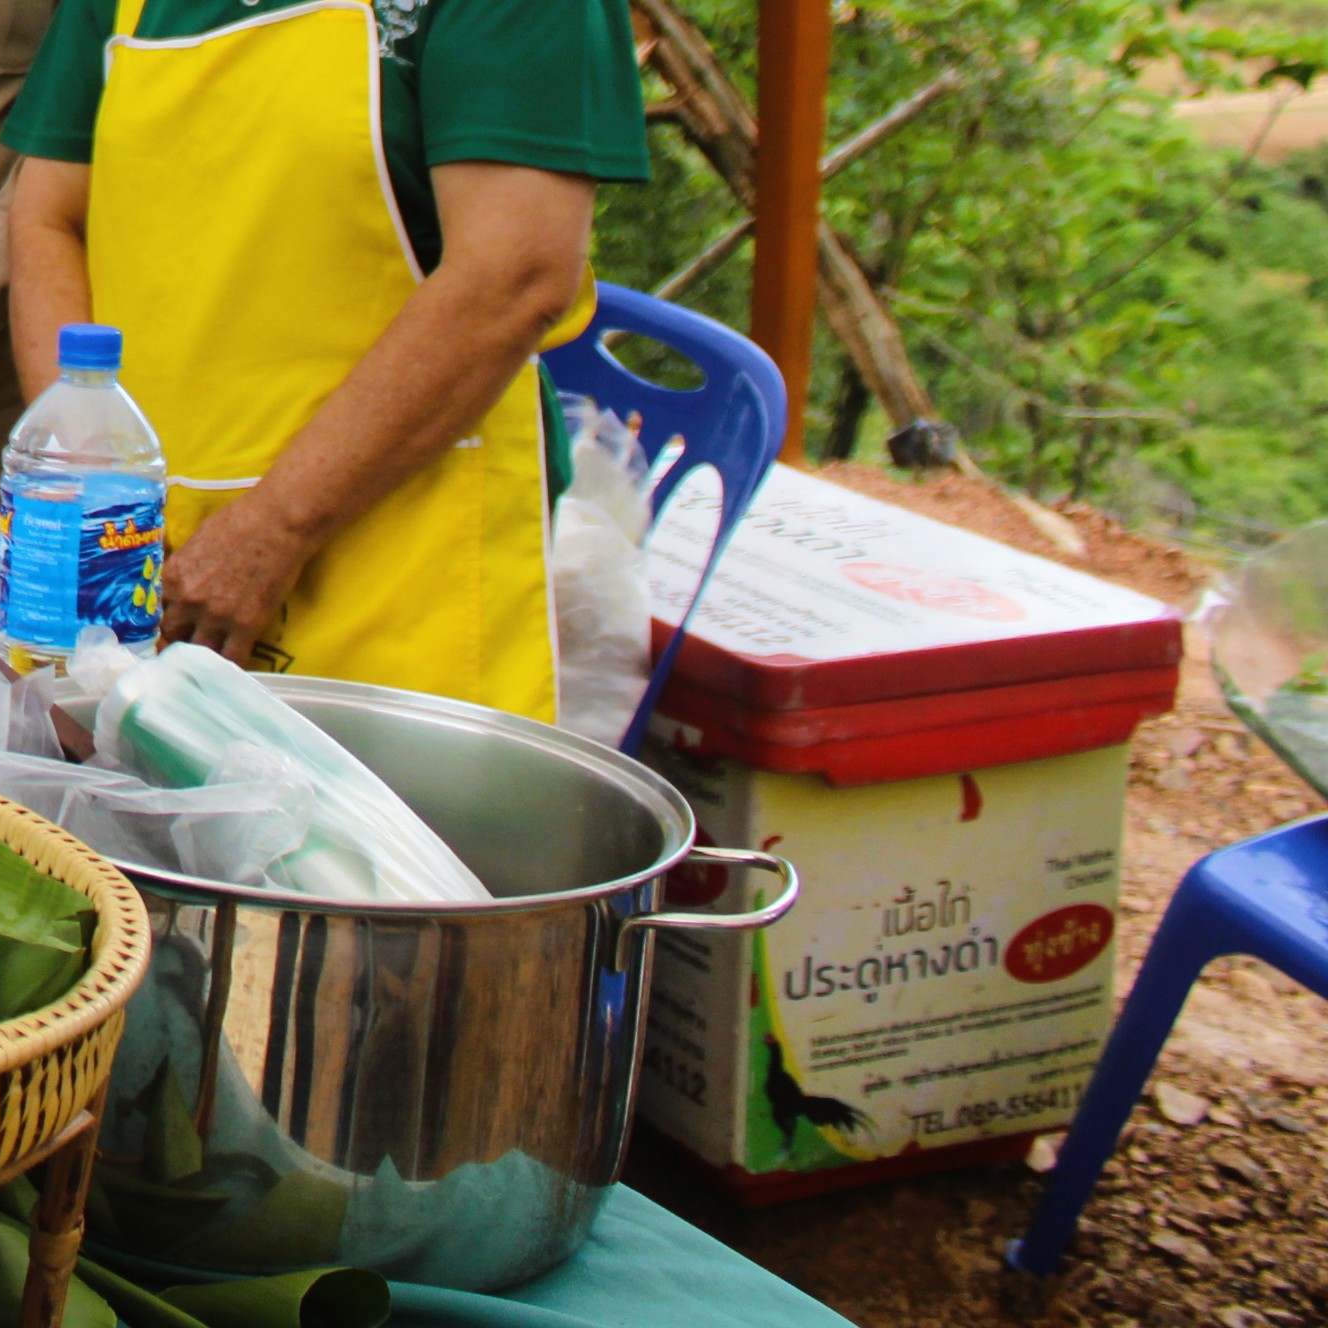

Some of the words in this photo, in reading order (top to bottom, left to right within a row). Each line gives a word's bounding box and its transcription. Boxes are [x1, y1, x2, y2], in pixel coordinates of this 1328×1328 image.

[882, 879, 974, 938] เนื้อไก่
[785, 925, 999, 1003] ประดู่หางดำ
